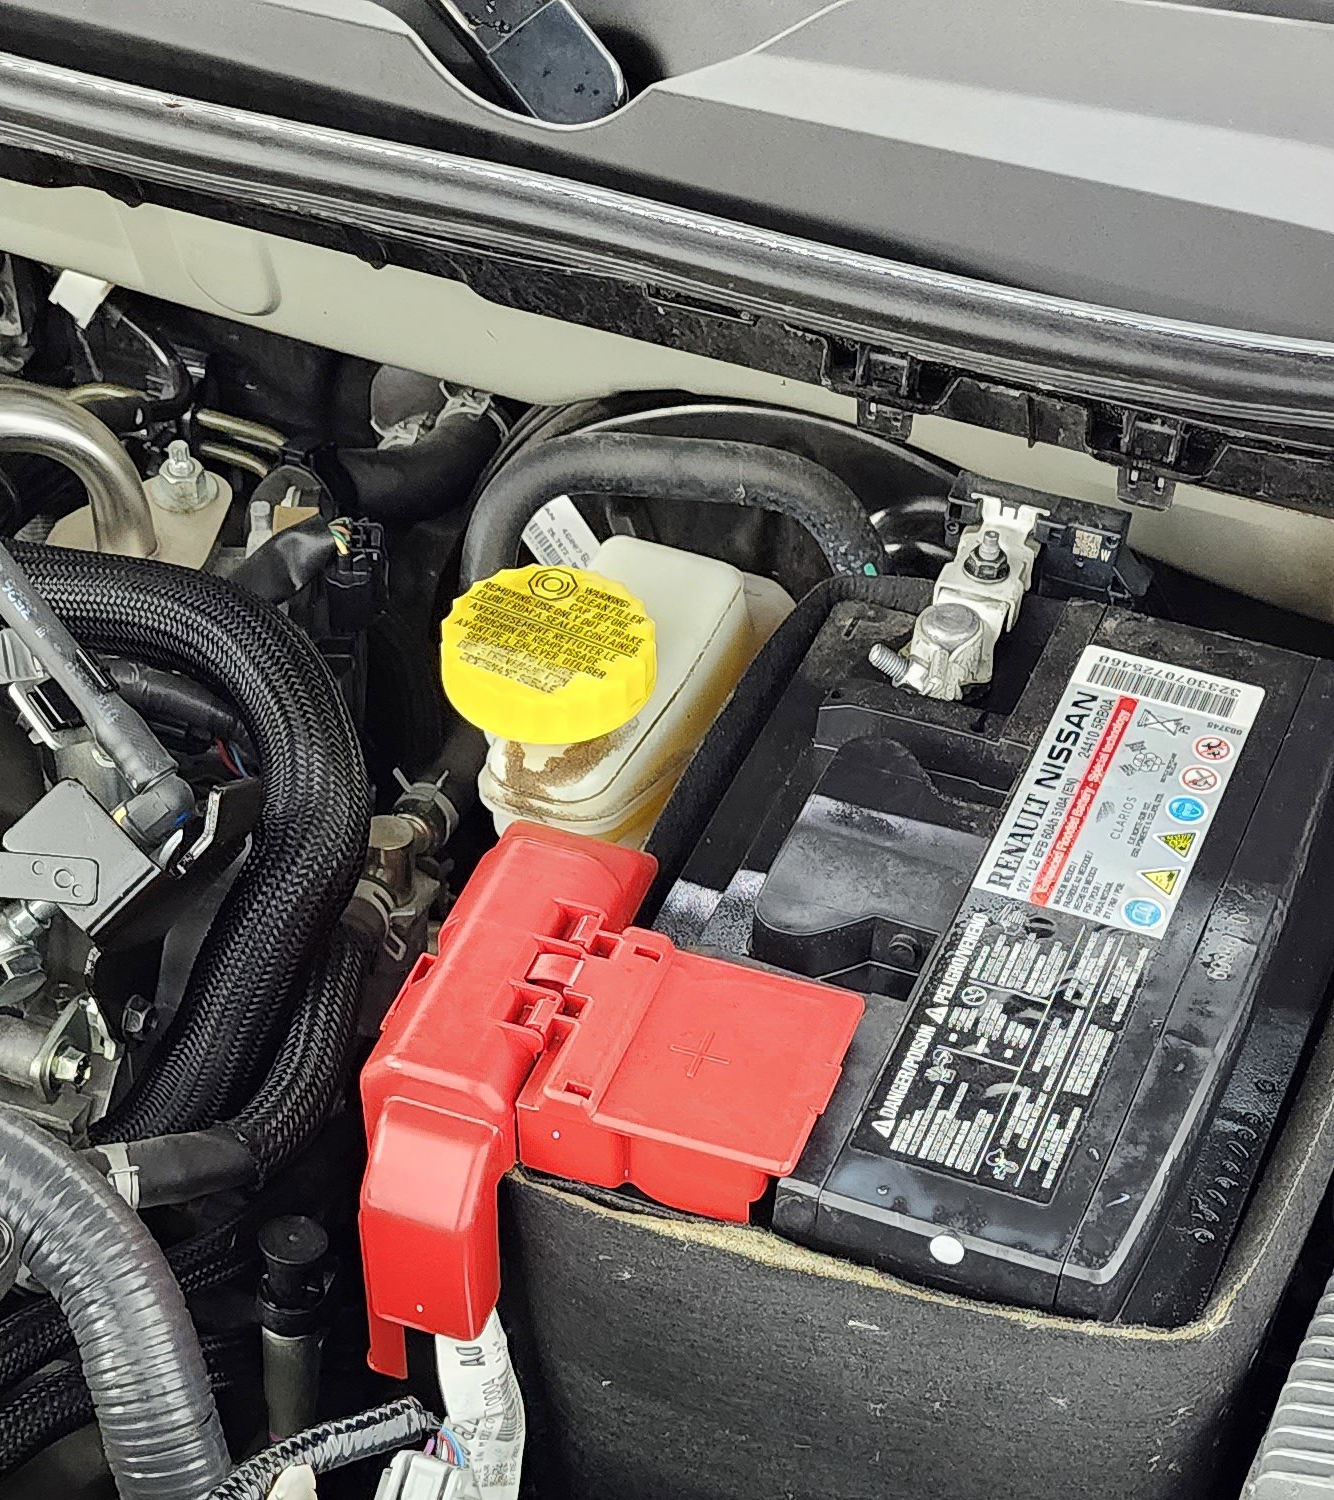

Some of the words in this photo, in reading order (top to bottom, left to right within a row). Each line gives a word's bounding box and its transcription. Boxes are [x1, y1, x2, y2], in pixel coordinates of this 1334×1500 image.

[505, 600, 535, 617] FROM
[543, 614, 583, 634] SEALED
[533, 599, 554, 613] USE
[609, 628, 645, 646] BRAKE
[568, 602, 590, 616] CAP
[592, 612, 630, 631] BEFORE
[575, 594, 608, 612] CLEAN
[609, 607, 644, 625] FILLER
[516, 629, 532, 640] DE
[531, 635, 601, 666] REMPLISSAGE
[603, 650, 619, 663] LE
[561, 657, 606, 679] UTILISER
[1077, 728, 1100, 758] 24410
[1072, 786, 1095, 817] Battery
[1100, 708, 1130, 753] technology
[985, 793, 1050, 889] RENAULT
[1032, 687, 1099, 790] NISSAN
[1061, 774, 1080, 797] (EN)
[1050, 793, 1069, 816] 510A
[1108, 794, 1138, 840] CLARIOS
[1040, 815, 1059, 838] 60Ah
[1026, 855, 1040, 869] L2
[1031, 838, 1048, 858] EFB
[1014, 873, 1032, 893] 12V
[933, 910, 989, 1005] PELIGRO/VENENO
[880, 1021, 936, 1117] DANGER/POISON
